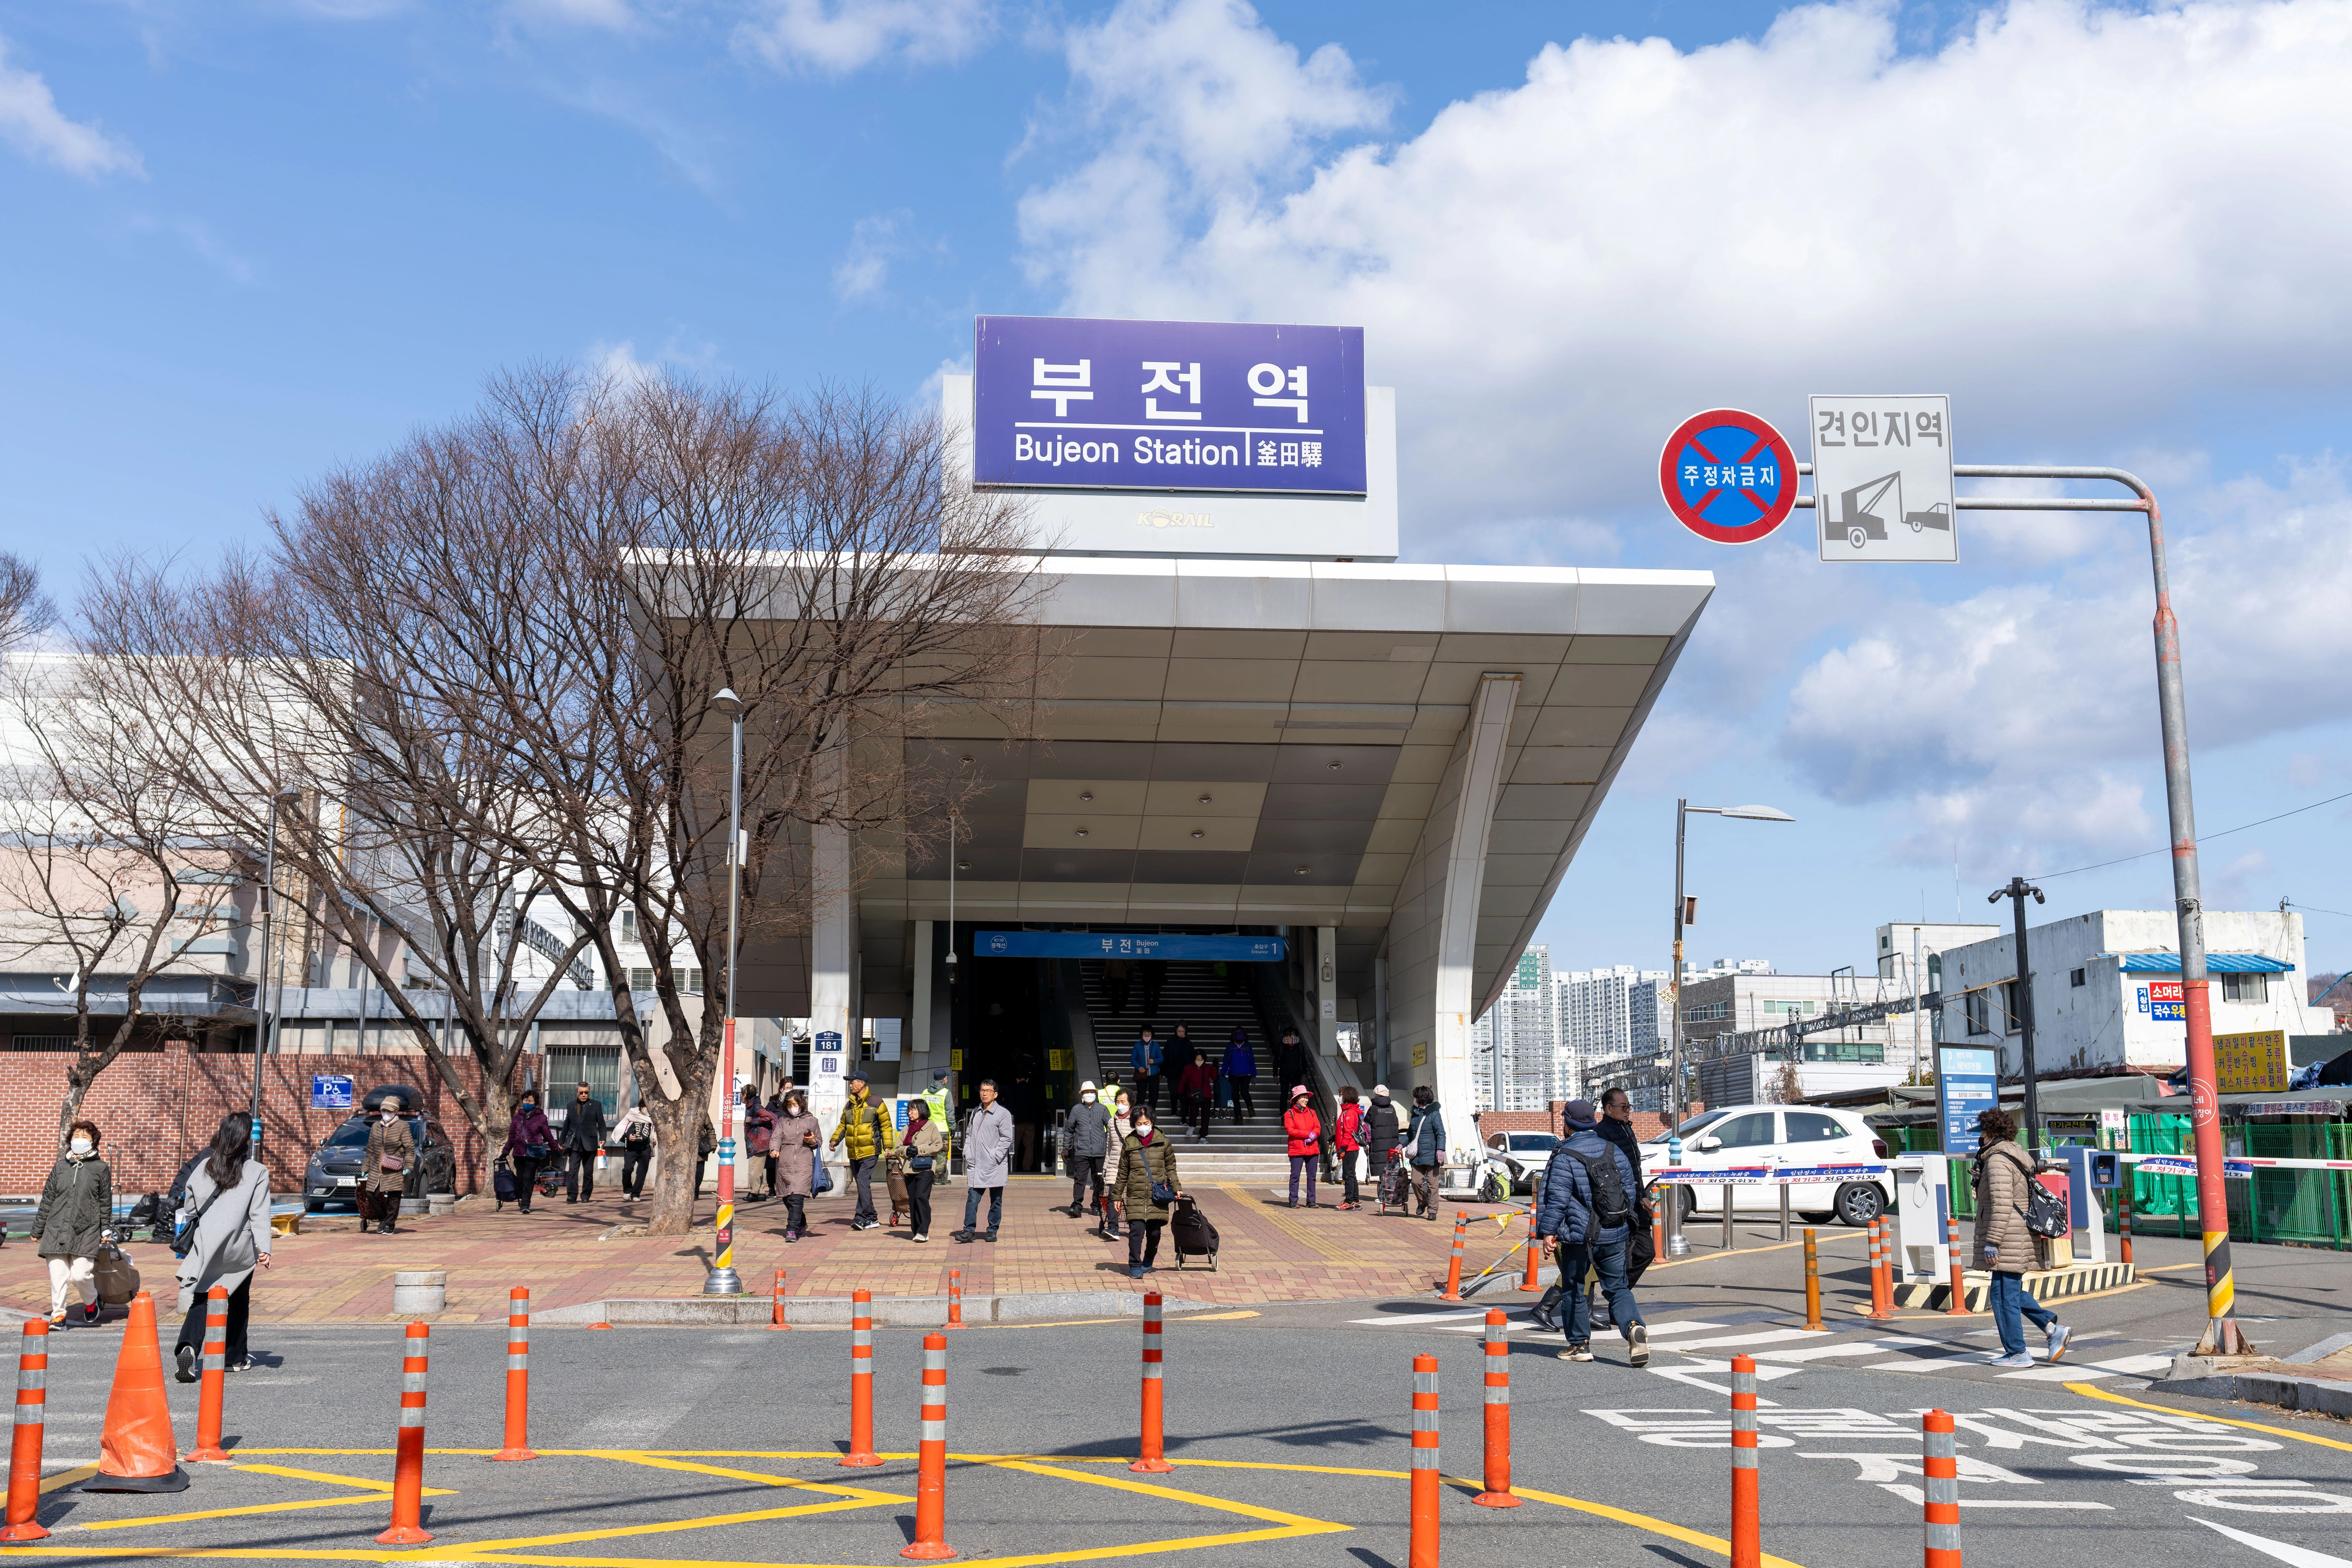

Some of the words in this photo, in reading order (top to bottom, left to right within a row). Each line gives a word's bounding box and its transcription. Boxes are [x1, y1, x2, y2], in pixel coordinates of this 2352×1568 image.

[1031, 357, 1308, 423] 부전역
[1818, 411, 1942, 447] 견인지역
[1015, 434, 1118, 466] Bujeon
[1134, 436, 1238, 466] Station
[1257, 440, 1322, 467] 釜田驛
[1684, 465, 1775, 487] 주정차금지
[1102, 939, 1131, 953] 부전
[1272, 943, 1277, 954] 1
[2139, 988, 2148, 1011] 거창집
[2153, 985, 2183, 999] 소머리
[821, 1041, 836, 1049] 181
[2264, 1103, 2283, 1114] 팥빙수
[2286, 1103, 2306, 1113] 토스트
[2308, 1102, 2336, 1114] 과일쥬스
[2154, 1158, 2181, 1166] 일단정지
[2032, 1223, 2043, 1232] ACID
[1795, 1452, 2352, 1515] 전용
